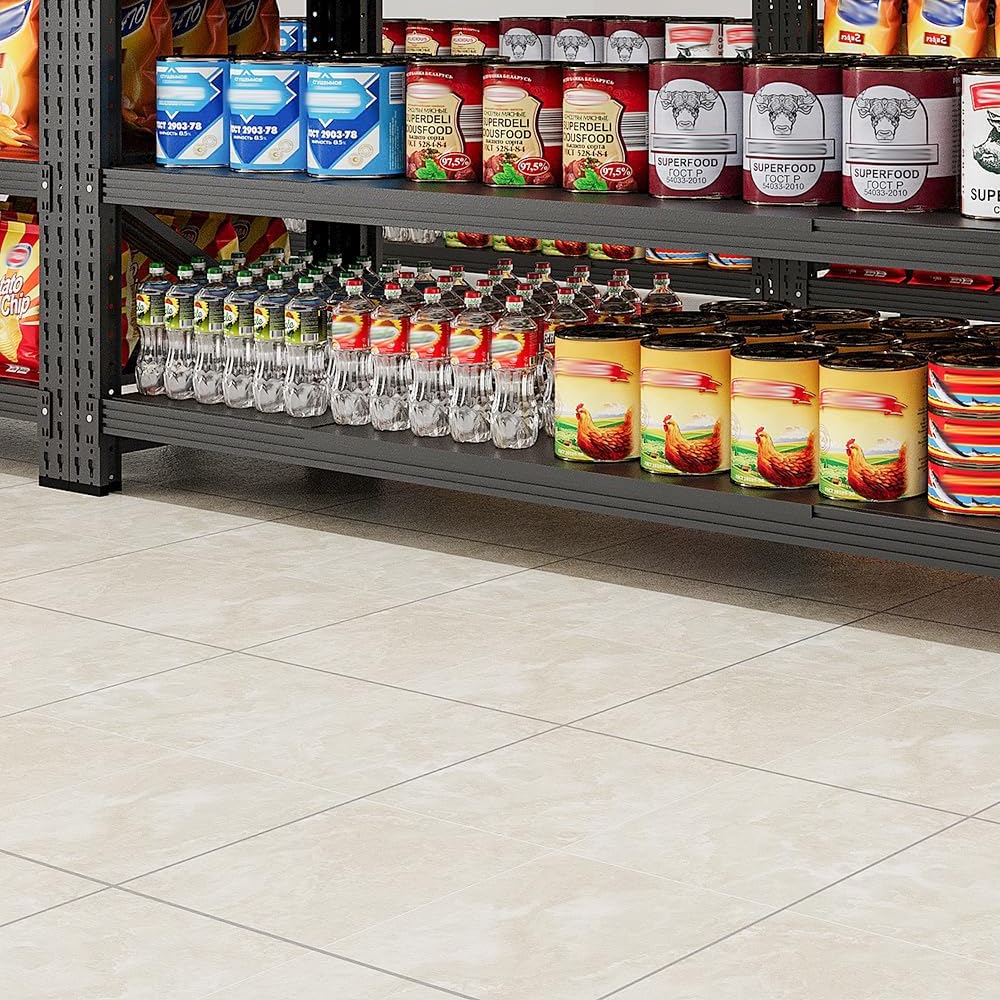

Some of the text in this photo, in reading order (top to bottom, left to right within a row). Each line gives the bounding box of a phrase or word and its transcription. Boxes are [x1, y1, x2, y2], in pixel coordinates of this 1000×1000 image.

[168, 121, 202, 130] 2903-78
[242, 126, 278, 135] 2903-78
[320, 130, 358, 140] 2903-78
[442, 157, 469, 166] 97,5%
[520, 161, 548, 172] 97,5%
[657, 156, 718, 168] SUPERFOOD
[602, 167, 631, 176] 97,5%
[752, 162, 816, 173] SUPERFOOD
[668, 168, 704, 178] ГОСТ Р
[854, 168, 920, 179] SUPERFOOD
[764, 174, 801, 184] ГОСТ Р
[762, 182, 804, 191] 54033-2010
[866, 180, 904, 190] ГОСТ Р
[864, 188, 908, 197] 54033-2010
[1, 291, 30, 320] Chip
